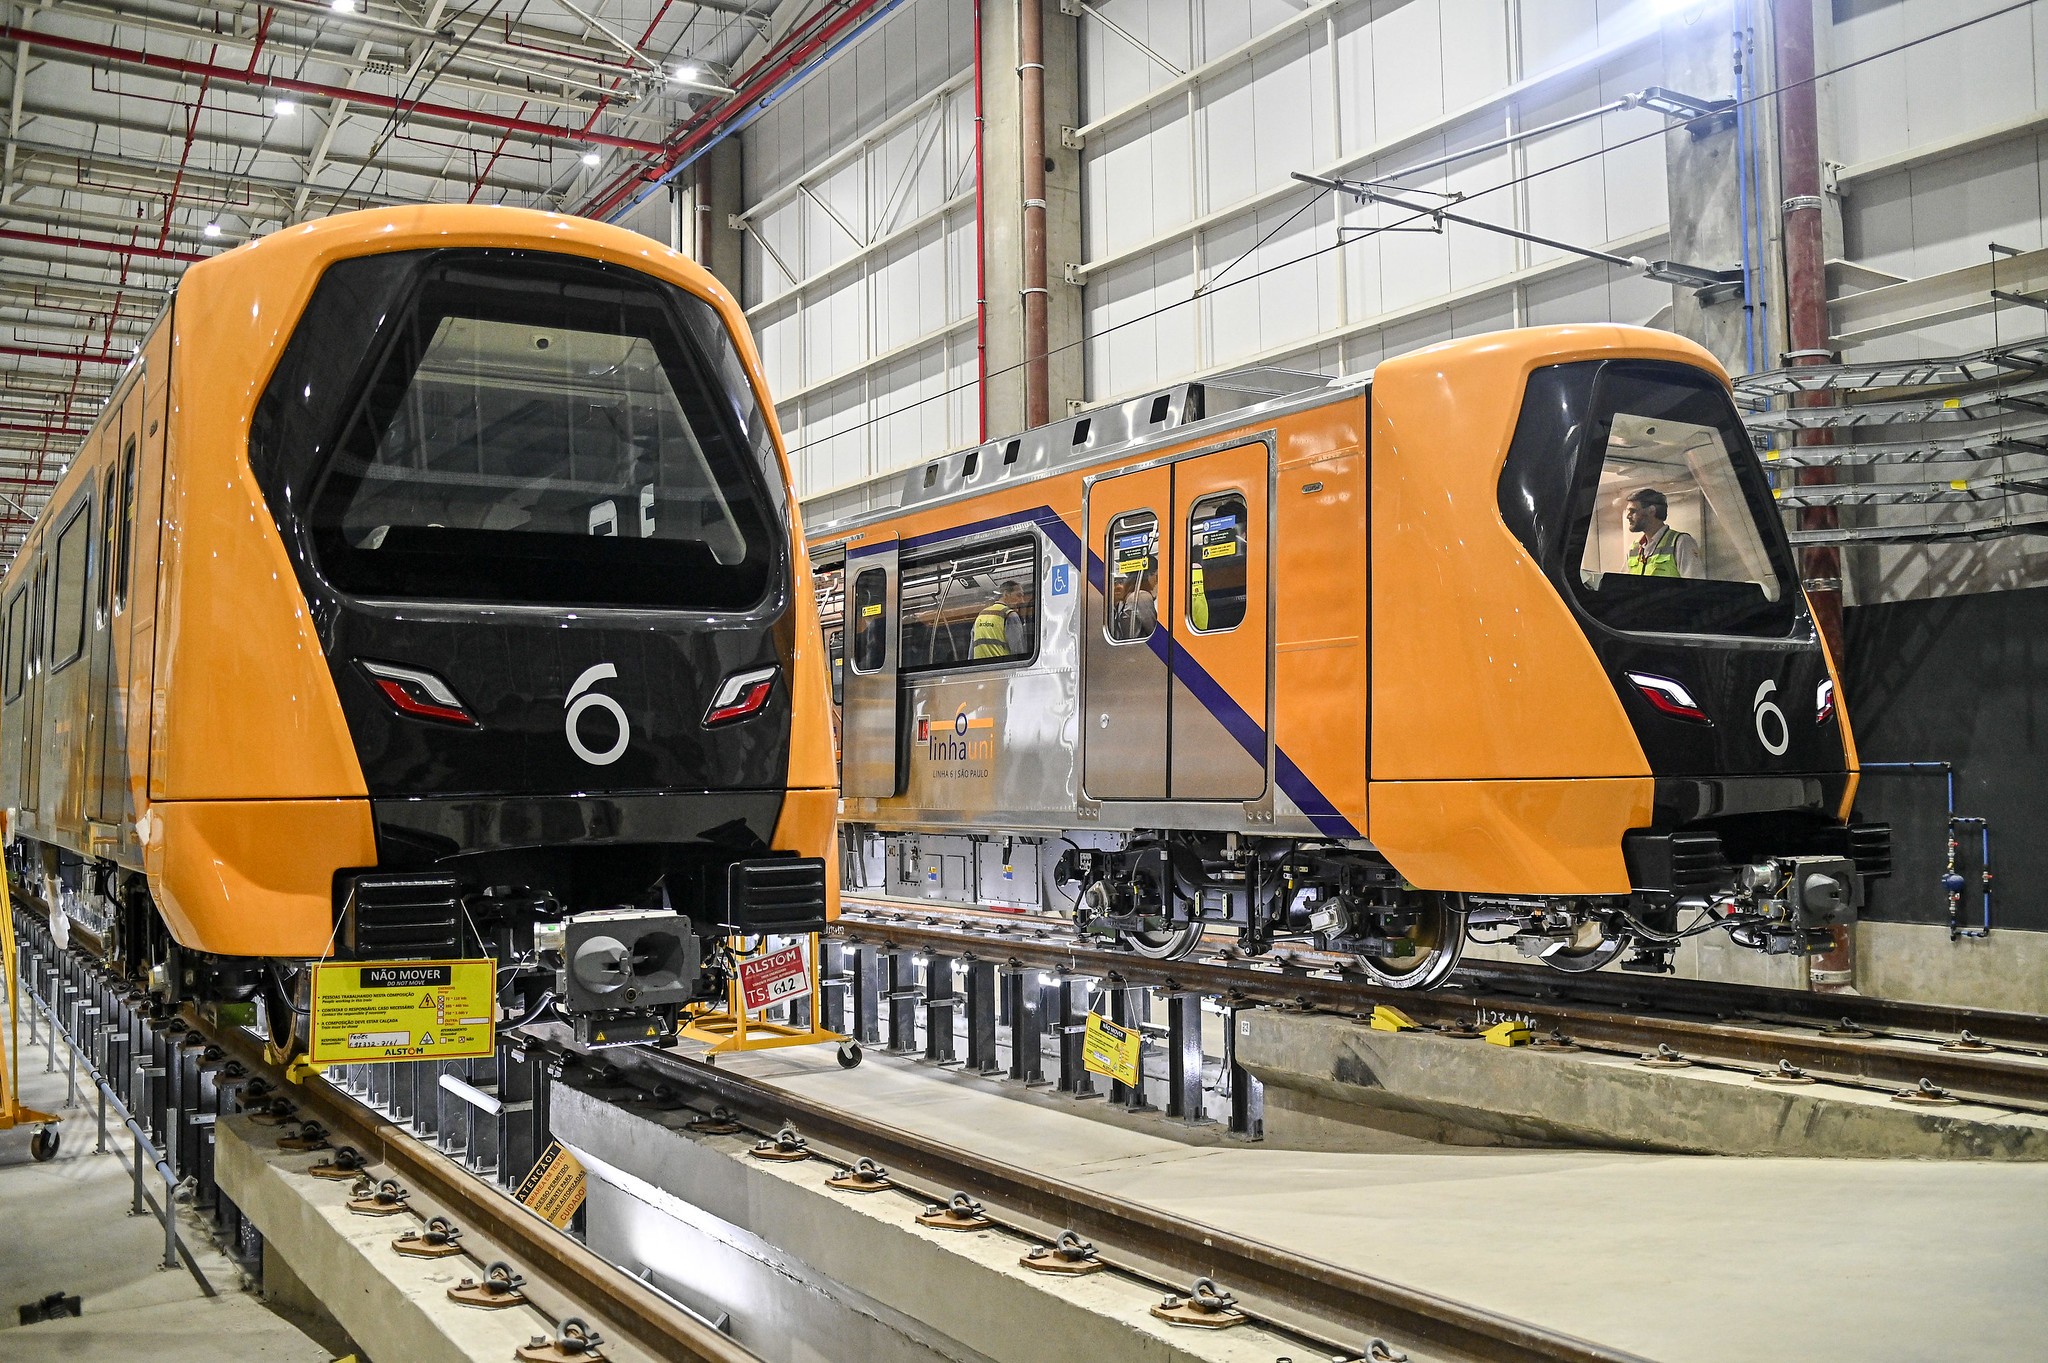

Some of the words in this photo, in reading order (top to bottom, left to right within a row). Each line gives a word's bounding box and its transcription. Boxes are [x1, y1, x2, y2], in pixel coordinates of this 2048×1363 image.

[564, 663, 630, 766] 6
[1753, 679, 1789, 755] 6
[932, 769, 949, 779] LINHA
[949, 769, 954, 779] 6
[957, 768, 969, 778] SÃO
[970, 769, 989, 778] PAULO
[371, 968, 397, 981] NÃO
[399, 969, 441, 980] MOVER
[745, 950, 797, 976] ALSTOM
[747, 987, 770, 1004] TS:
[773, 977, 796, 995] 612
[384, 1047, 424, 1056] ALSTOM
[518, 1151, 556, 1201] ATENÇÃO!
[534, 1190, 550, 1211] ACESSO
[548, 1163, 570, 1191] PERMITIDO
[543, 1187, 561, 1211] SOMENTE
[560, 1174, 574, 1189] PARA
[559, 1169, 587, 1204] AUTORIZADAS
[560, 1186, 587, 1221] CUIDADO!
